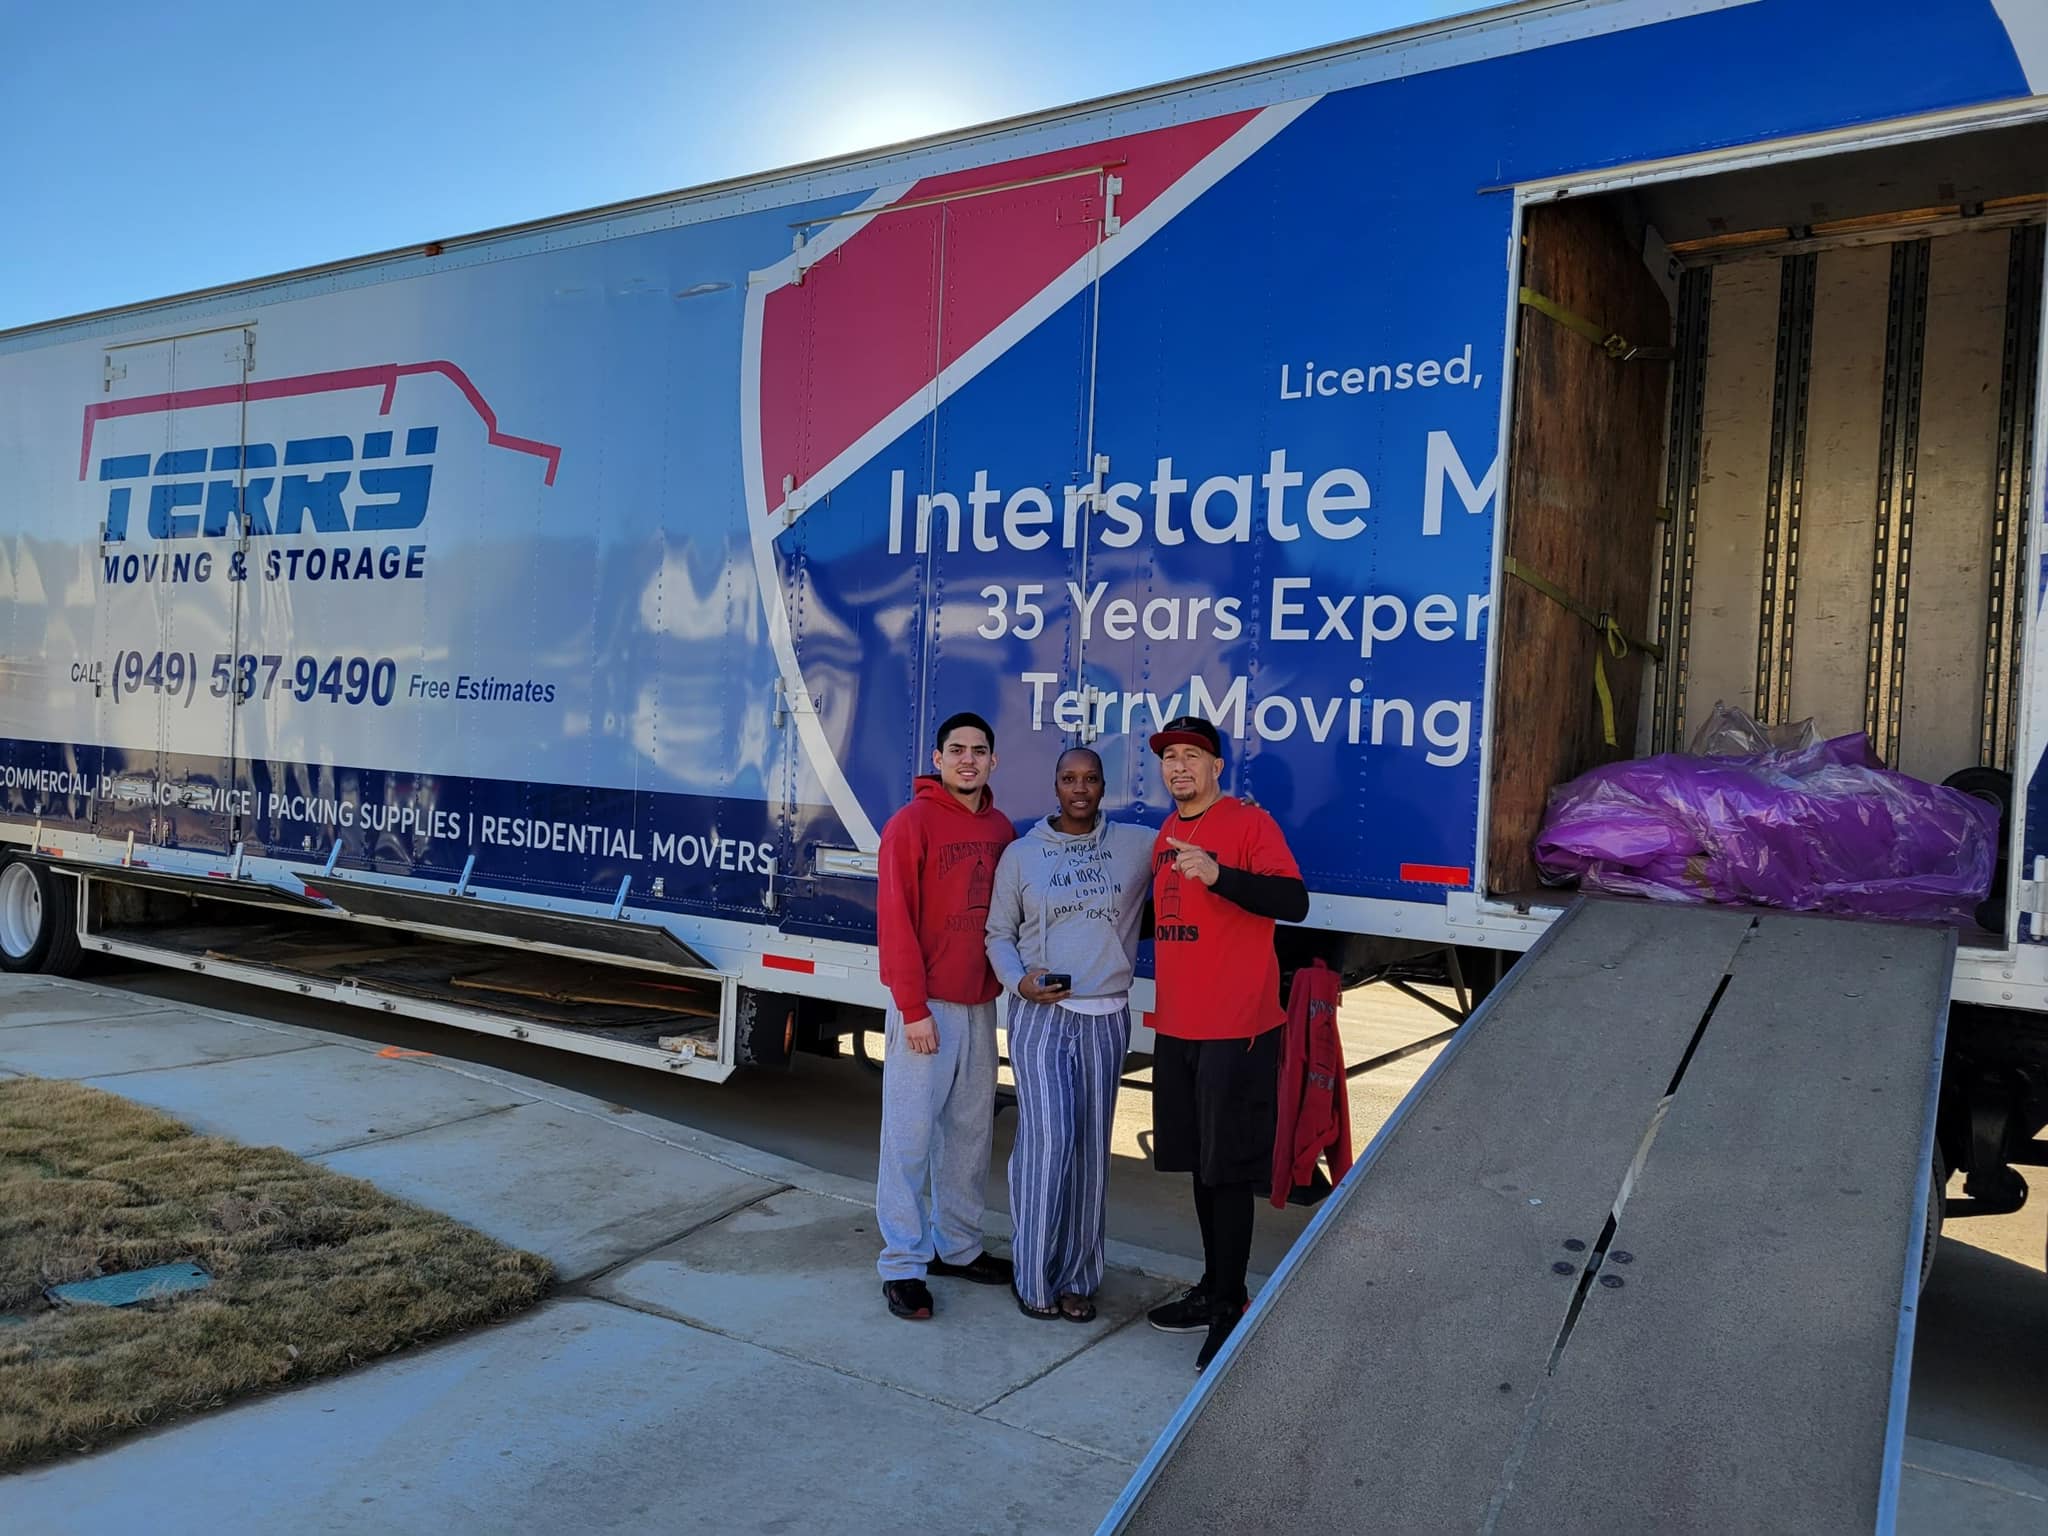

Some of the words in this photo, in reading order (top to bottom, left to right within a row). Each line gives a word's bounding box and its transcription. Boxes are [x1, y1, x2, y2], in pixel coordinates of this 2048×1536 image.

[1280, 343, 1483, 399] Licensed,
[99, 426, 438, 542] TERRY
[887, 448, 1371, 554] Interstate
[103, 551, 213, 584] MOVING
[228, 550, 248, 583] &
[265, 545, 427, 581] STORAGE
[977, 583, 1044, 641] 35
[1067, 581, 1243, 642] Years
[1270, 577, 1491, 659] Exper
[111, 650, 197, 708] (949)
[210, 653, 397, 706] 587-9490
[409, 674, 449, 699] Free
[455, 675, 556, 702] Estimates
[0, 764, 91, 796] COMMERCIAL
[268, 796, 354, 828] PACKING
[360, 804, 460, 840] SUPPLIES
[481, 814, 643, 861] RESIDENTIAL
[652, 831, 775, 875] MOVERS
[1049, 871, 1071, 887] NEW
[1075, 867, 1106, 883] YORK
[1075, 883, 1122, 899] LONDN
